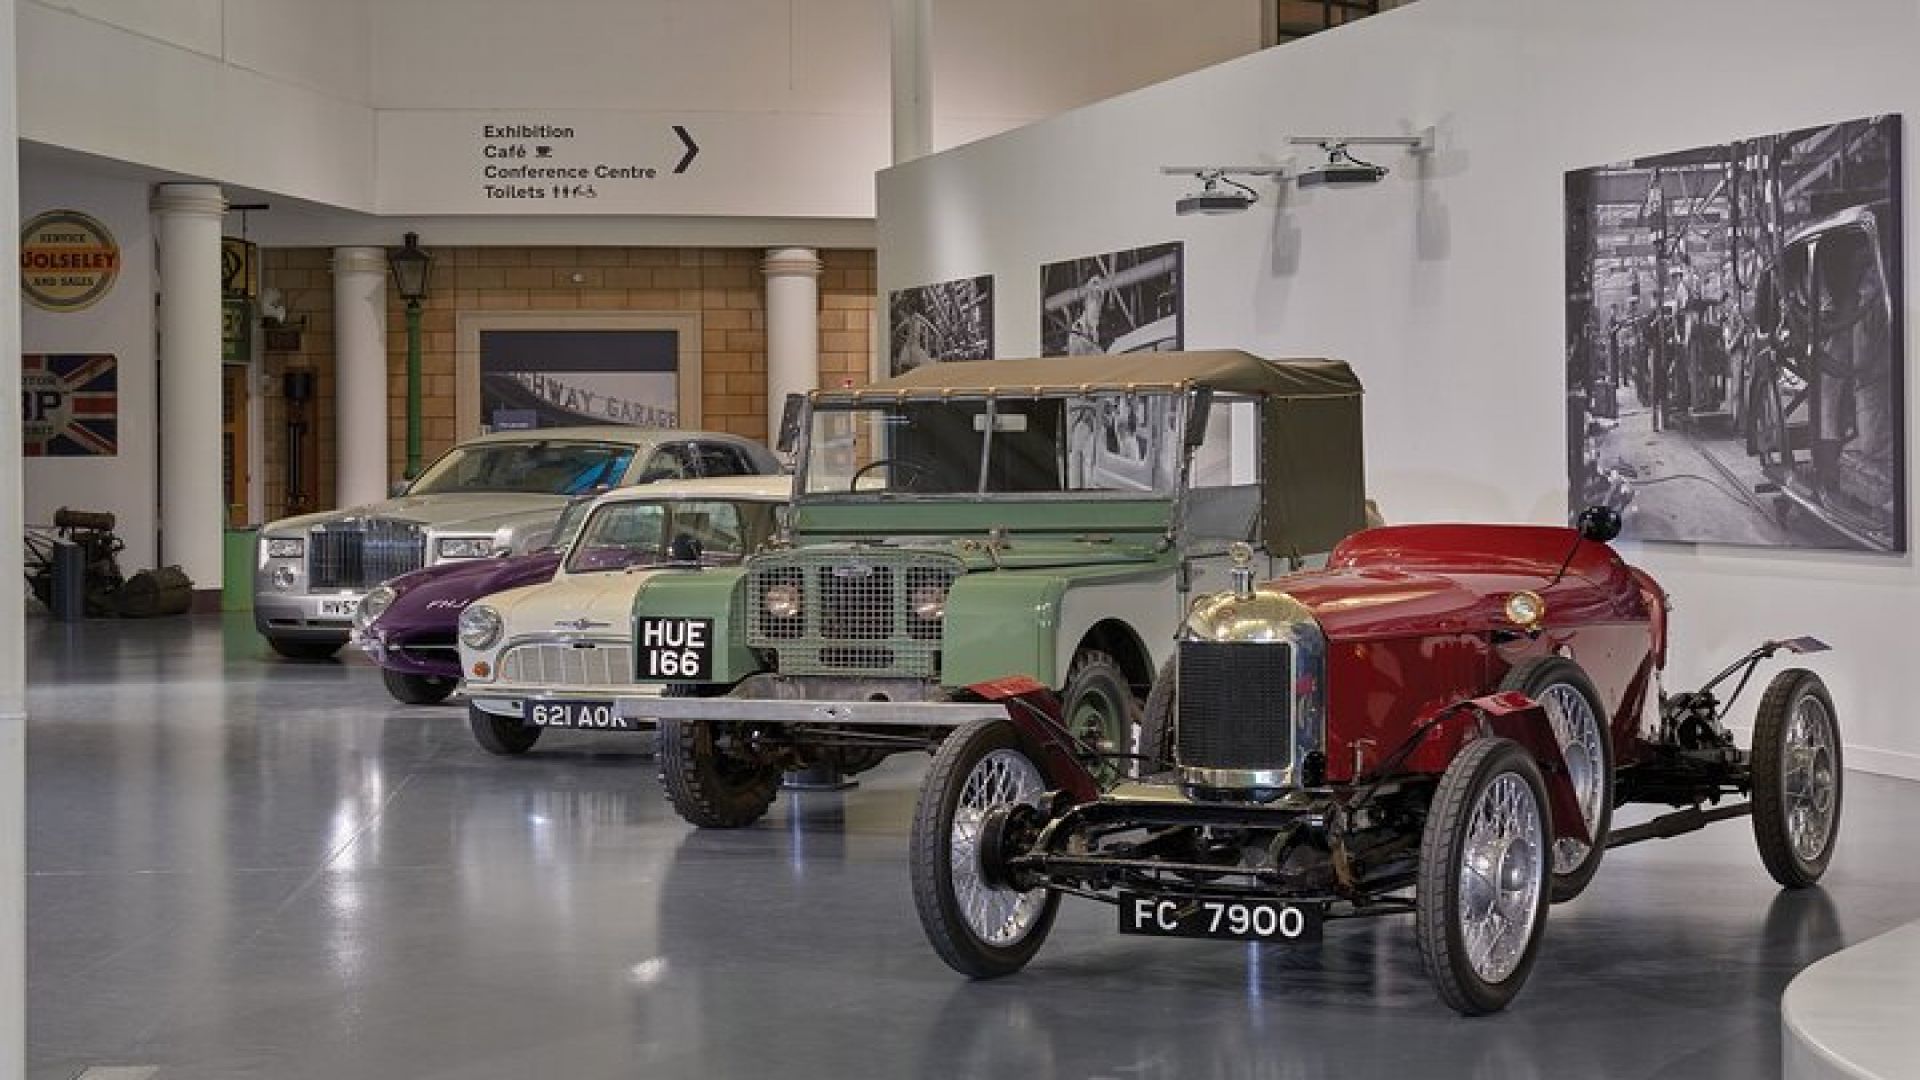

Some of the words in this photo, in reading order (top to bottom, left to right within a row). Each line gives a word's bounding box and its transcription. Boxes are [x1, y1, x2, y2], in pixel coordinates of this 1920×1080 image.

[483, 125, 575, 139] Exhibition
[483, 144, 527, 159] Café
[483, 164, 589, 179] Conference
[594, 164, 657, 179] Centre
[484, 184, 546, 199] Toilets
[643, 620, 706, 648] HUE
[649, 649, 700, 676] 166
[532, 705, 572, 726] 621
[1135, 899, 1179, 930] FC
[1204, 902, 1305, 937] 7900
